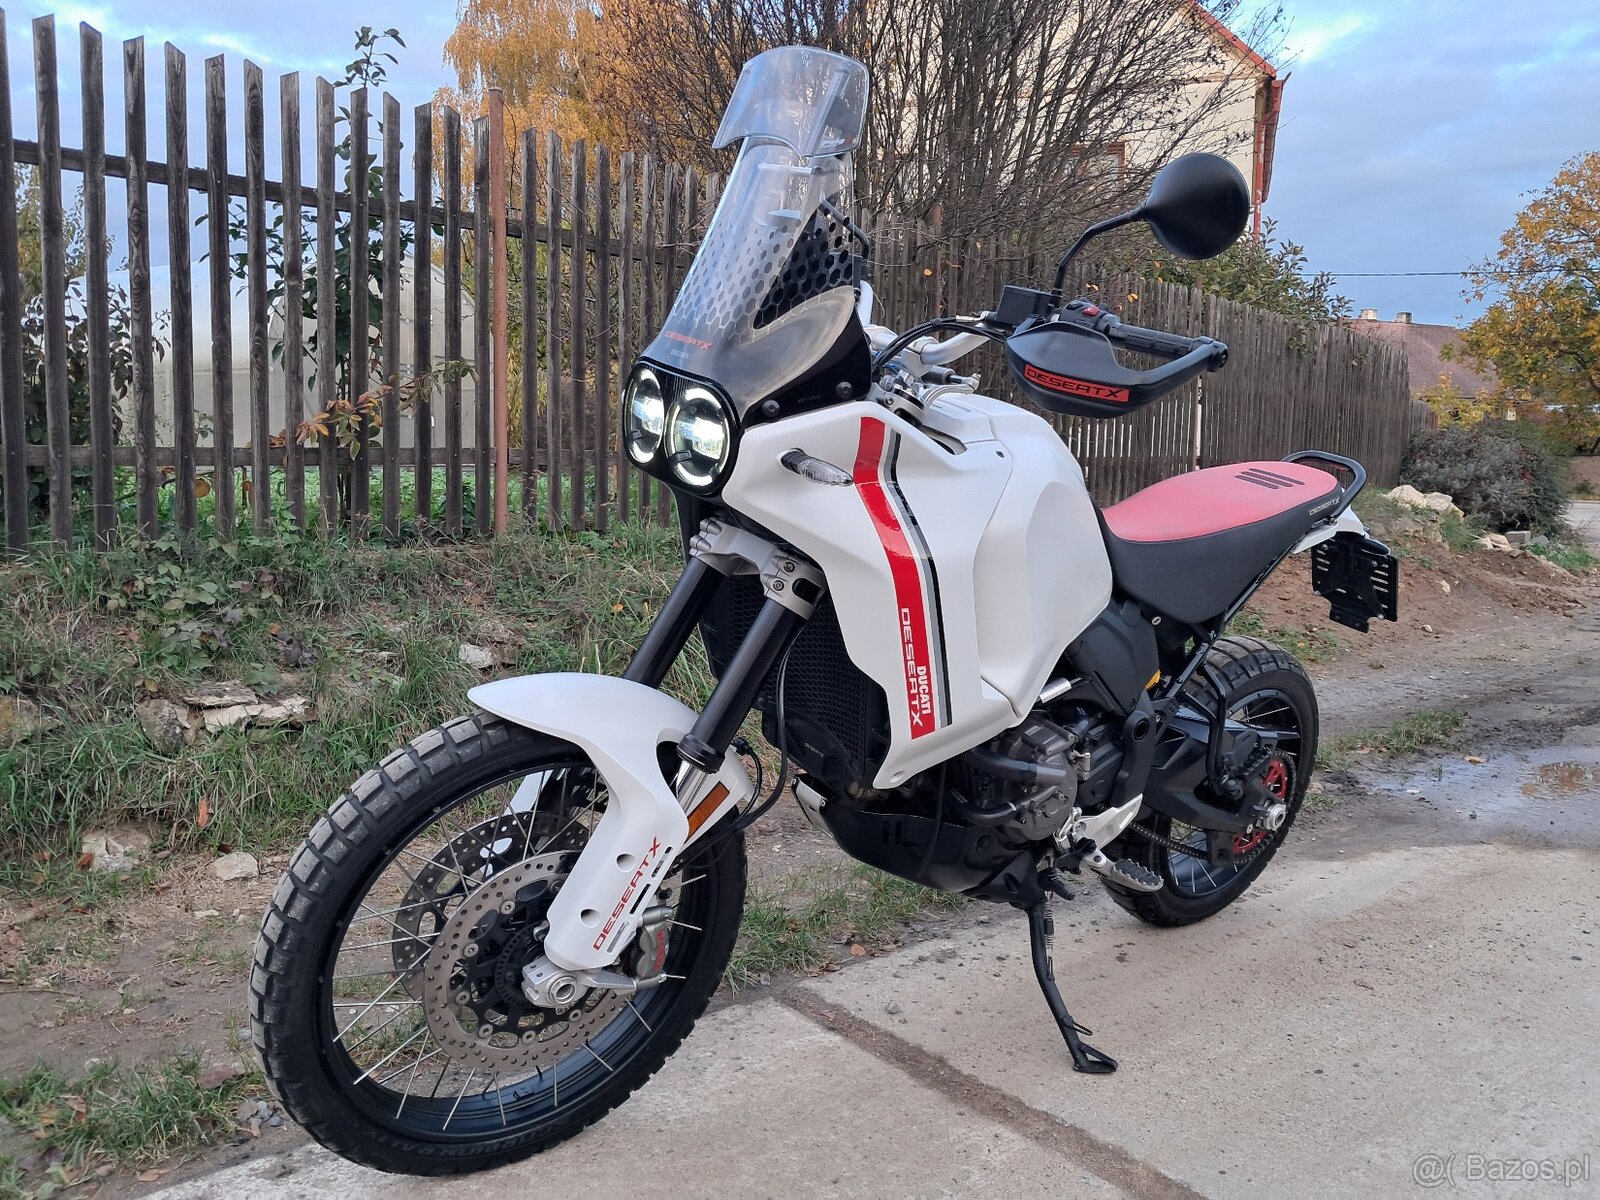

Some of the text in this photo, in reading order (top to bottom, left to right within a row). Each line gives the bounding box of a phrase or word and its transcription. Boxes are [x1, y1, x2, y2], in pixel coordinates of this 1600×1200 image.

[1026, 368, 1124, 398] DESERTX
[1308, 496, 1340, 516] DESERTX
[901, 607, 923, 728] DESERTX
[916, 665, 932, 715] DUCATI
[593, 835, 661, 951] DESERTX
